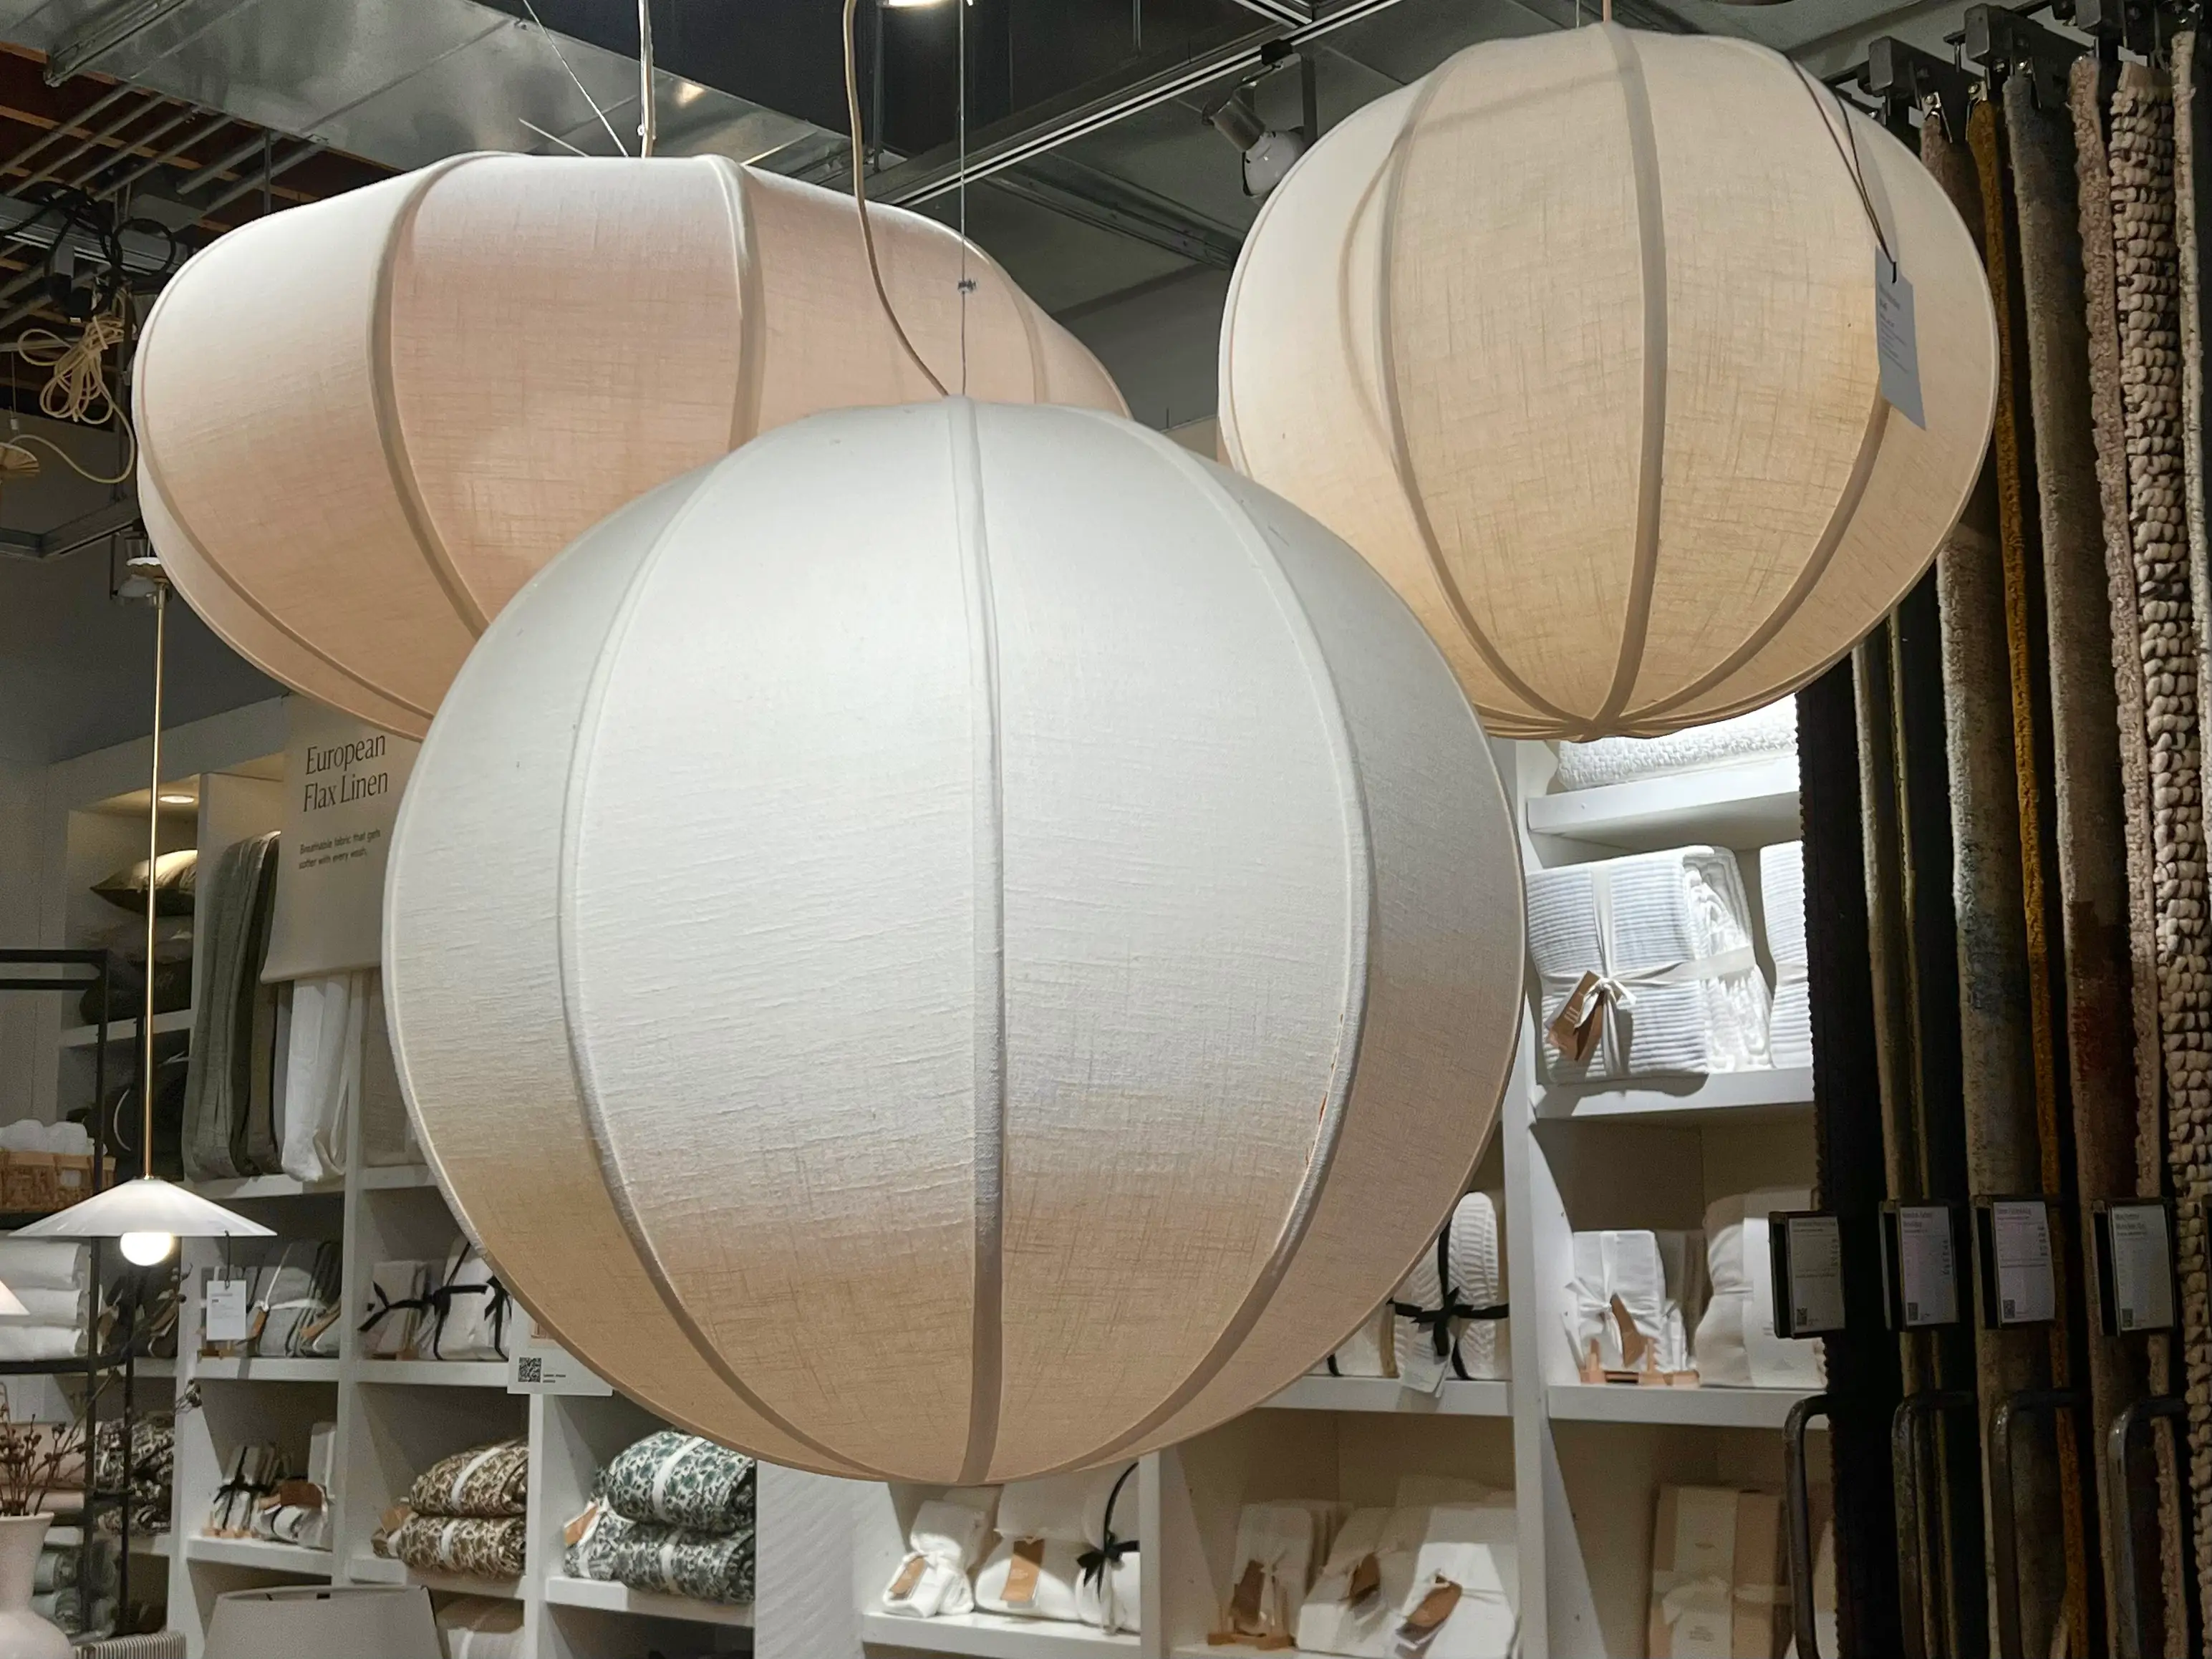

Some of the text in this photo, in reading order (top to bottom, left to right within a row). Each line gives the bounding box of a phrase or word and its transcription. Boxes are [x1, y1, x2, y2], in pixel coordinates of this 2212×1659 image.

[306, 735, 386, 775] European
[303, 772, 389, 812] Flax Linen
[332, 852, 349, 863] every
